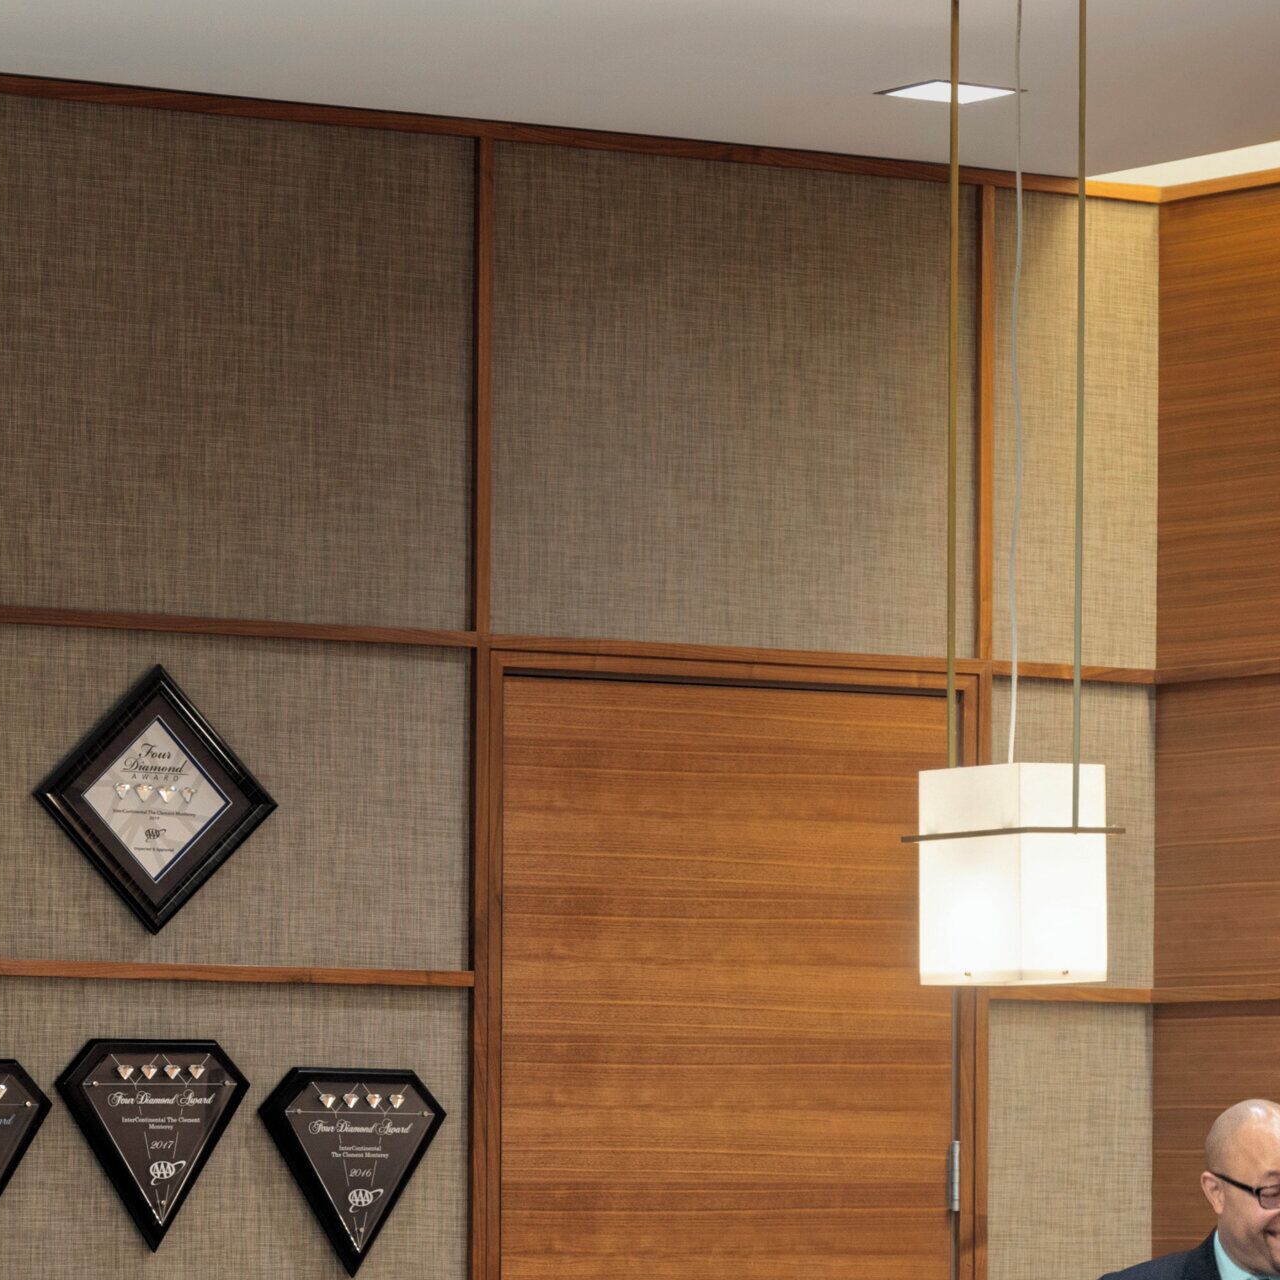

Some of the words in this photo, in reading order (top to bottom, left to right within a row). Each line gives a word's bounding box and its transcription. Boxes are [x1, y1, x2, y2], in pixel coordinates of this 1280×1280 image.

[138, 743, 172, 759] Four
[122, 757, 188, 773] Diamond
[131, 774, 179, 782] AWARD
[108, 1091, 134, 1107] Four
[136, 1090, 177, 1105] Diamond
[176, 1089, 216, 1107] Award
[148, 1123, 174, 1131] Monterey
[308, 1119, 335, 1135] Four
[336, 1118, 376, 1133] Diamond
[375, 1118, 413, 1136] Award
[149, 1140, 174, 1150] 2017
[150, 1161, 175, 1179] AAA
[349, 1168, 373, 1178] 2016
[348, 1189, 373, 1207] AAA
